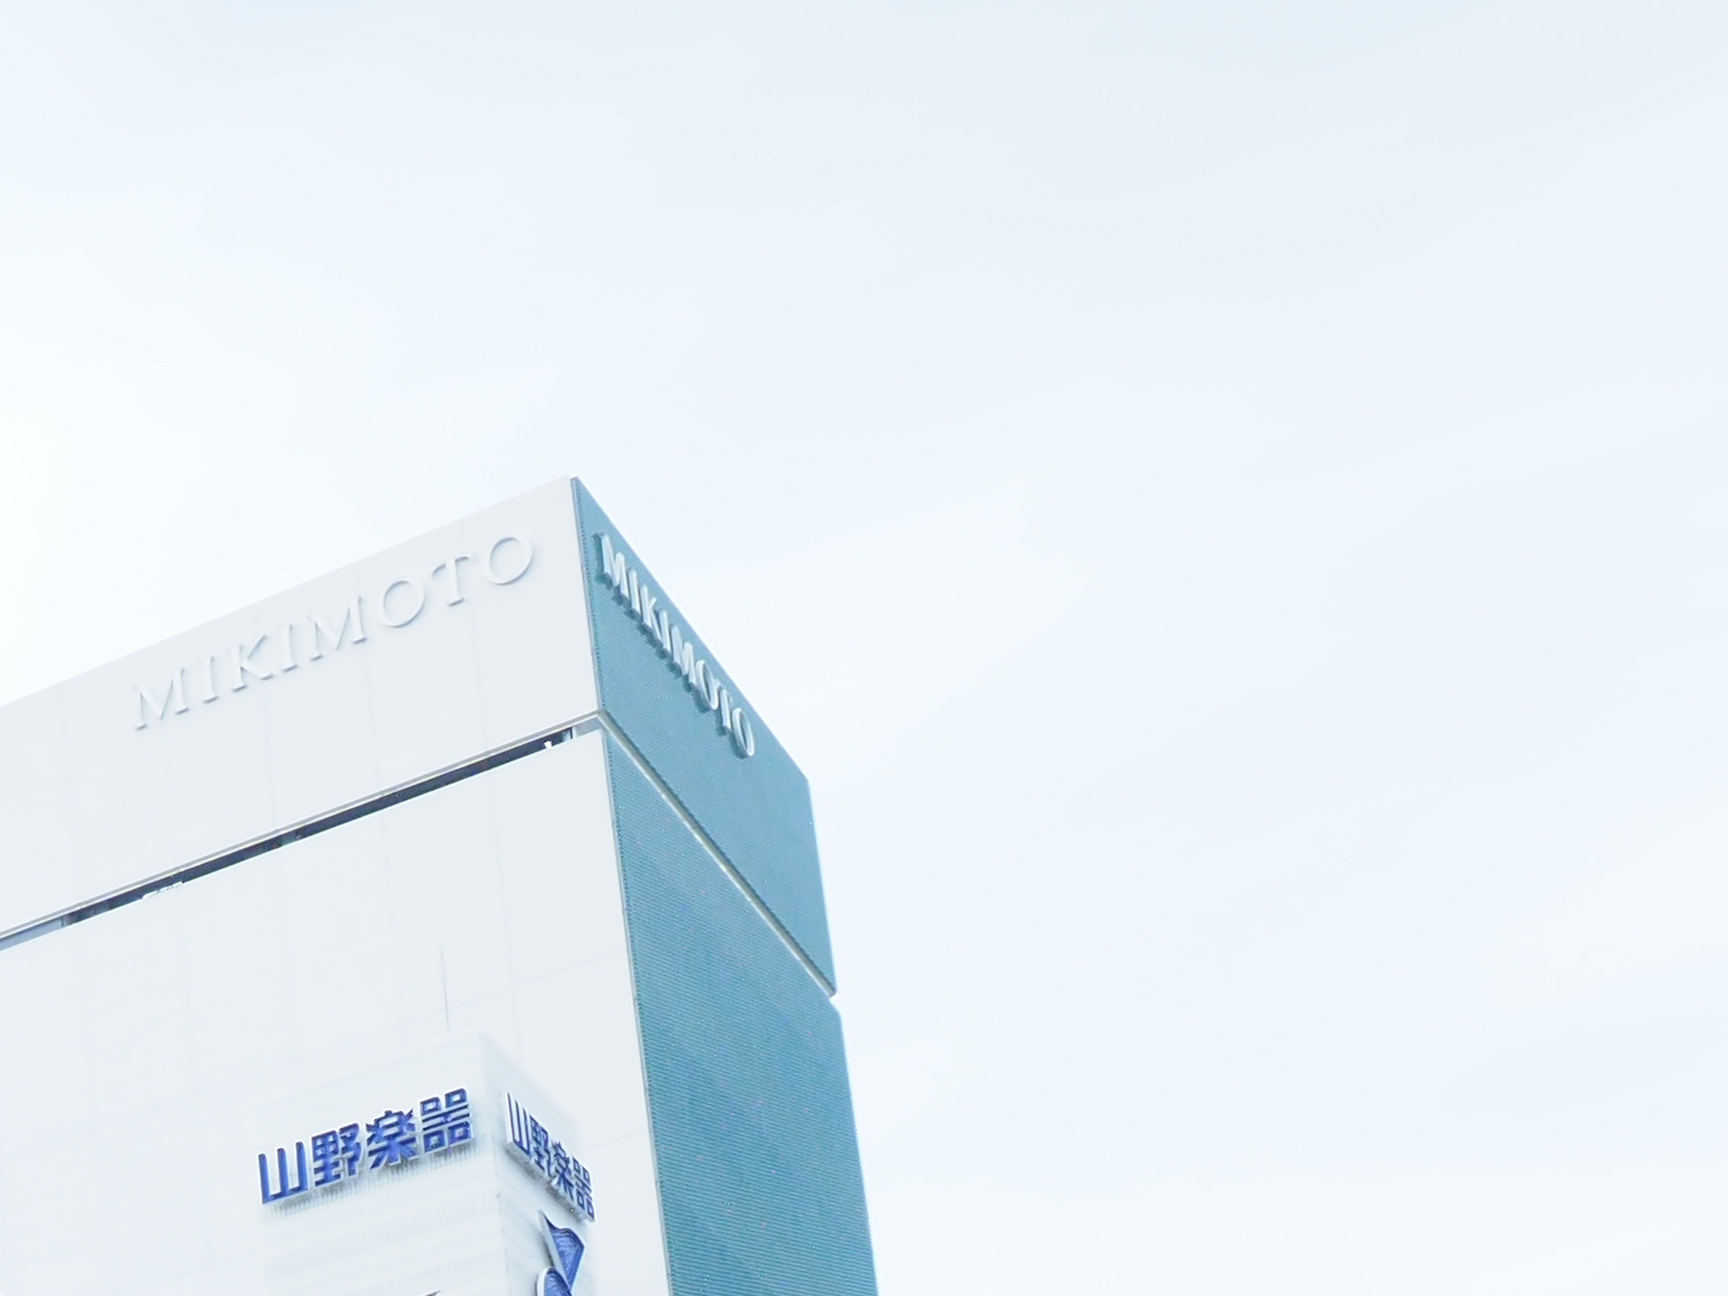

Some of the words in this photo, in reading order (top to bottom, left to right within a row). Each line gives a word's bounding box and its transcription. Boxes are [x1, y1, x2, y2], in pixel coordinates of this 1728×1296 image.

[132, 532, 536, 732] MIKIMOTO
[599, 533, 756, 758] MIKIMOTO
[257, 1088, 476, 1206] 山野楽器
[504, 1091, 597, 1223] 山野楽器
